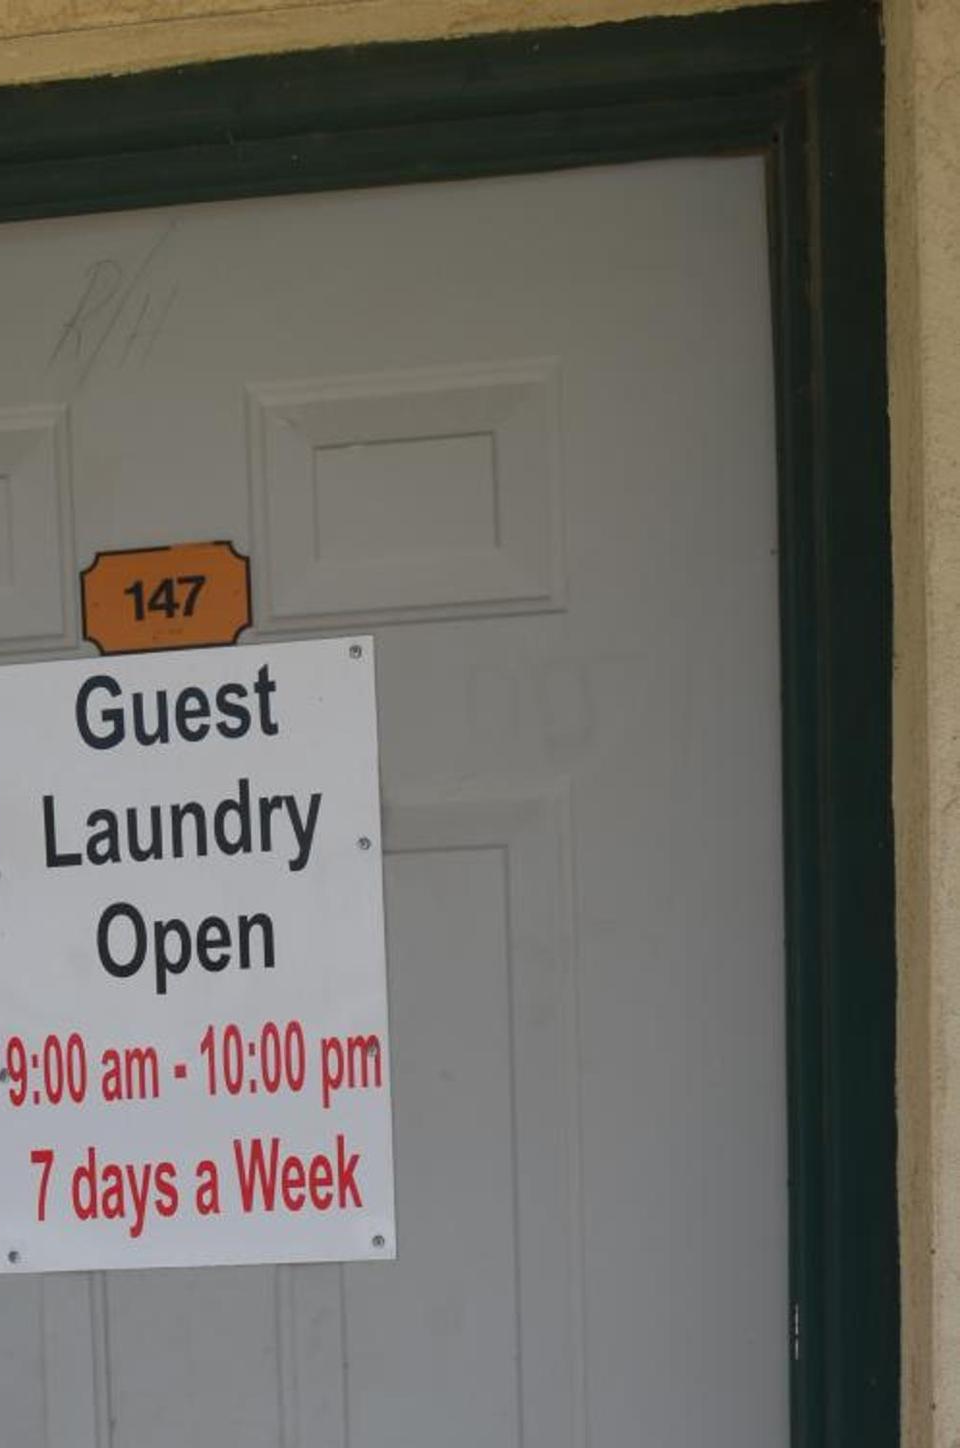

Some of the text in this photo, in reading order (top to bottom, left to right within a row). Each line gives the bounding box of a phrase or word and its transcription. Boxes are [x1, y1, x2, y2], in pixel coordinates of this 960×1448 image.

[124, 574, 207, 621] 147
[75, 664, 279, 750] Guest
[42, 778, 323, 872] Laundry
[96, 902, 276, 994] Open
[6, 1032, 89, 1107] 9:00
[100, 1045, 160, 1102] am
[200, 1020, 306, 1096] 10:00
[321, 1034, 382, 1108] pm
[30, 1134, 363, 1238] 7 days a Week
